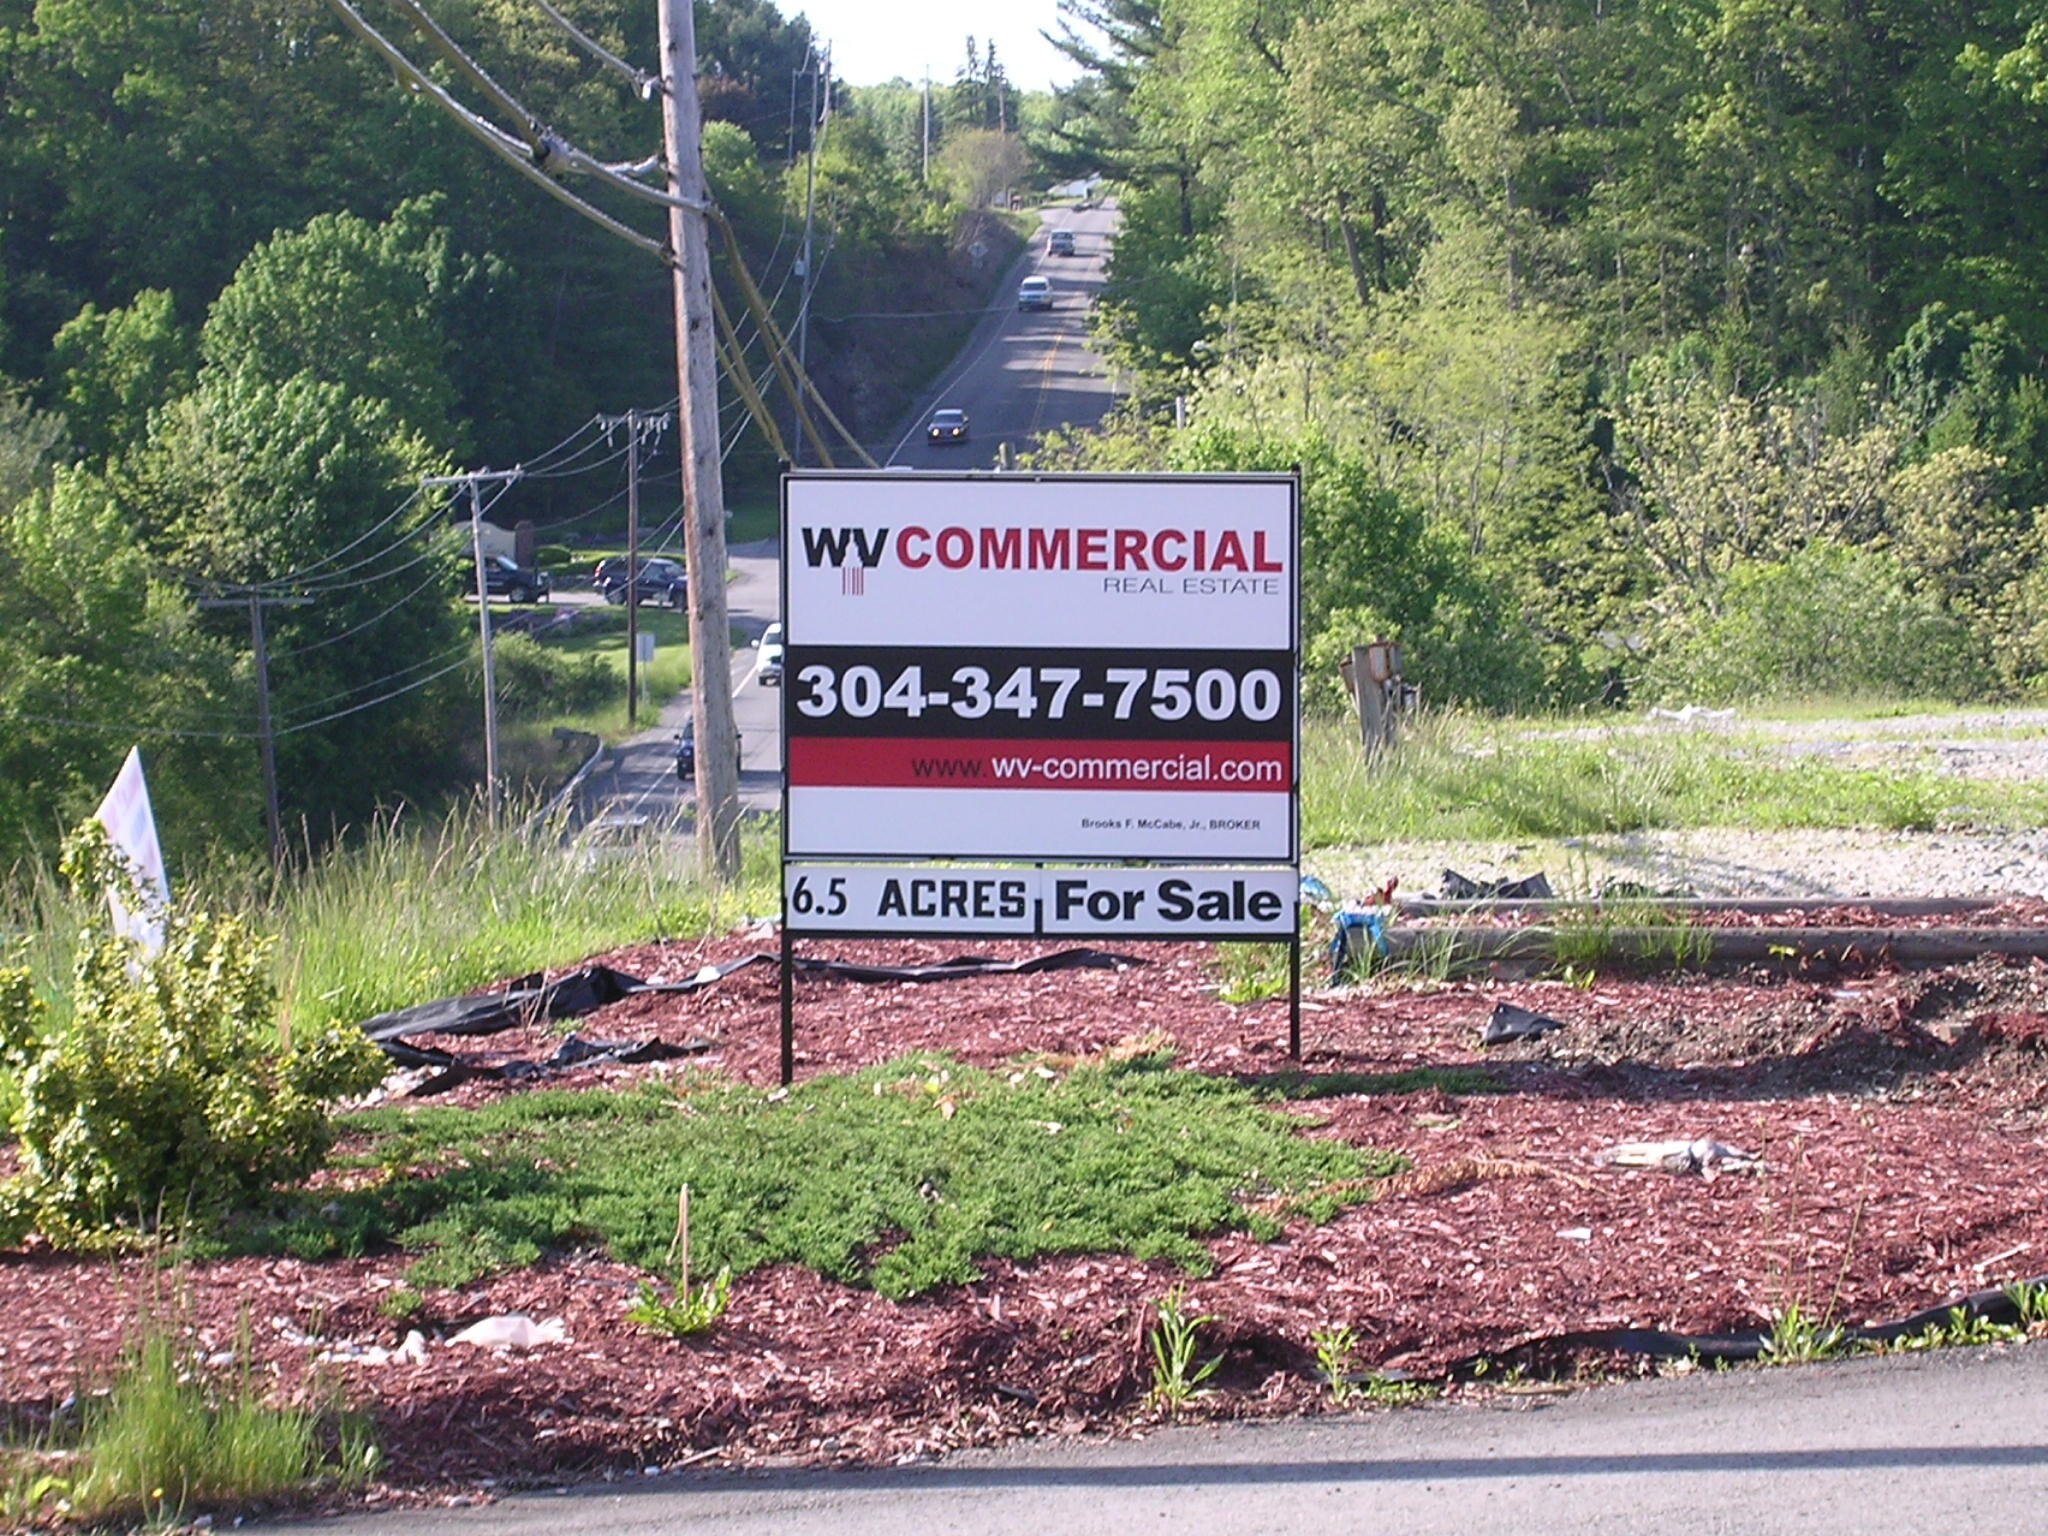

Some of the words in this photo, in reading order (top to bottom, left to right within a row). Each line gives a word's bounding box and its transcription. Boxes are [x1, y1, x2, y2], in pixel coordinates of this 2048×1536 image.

[1104, 577, 1173, 594] REAL
[1183, 578, 1280, 595] ESTATE
[797, 665, 1282, 721] 304-347-7500
[1081, 818, 1121, 830] Brooks
[1125, 819, 1134, 829] F.
[1137, 818, 1186, 831] McCabe,
[1209, 819, 1261, 831] BROKER
[791, 876, 848, 917] 6.5
[877, 878, 1026, 918] ACRES
[1055, 881, 1143, 920] For
[1157, 880, 1282, 921] Sale
